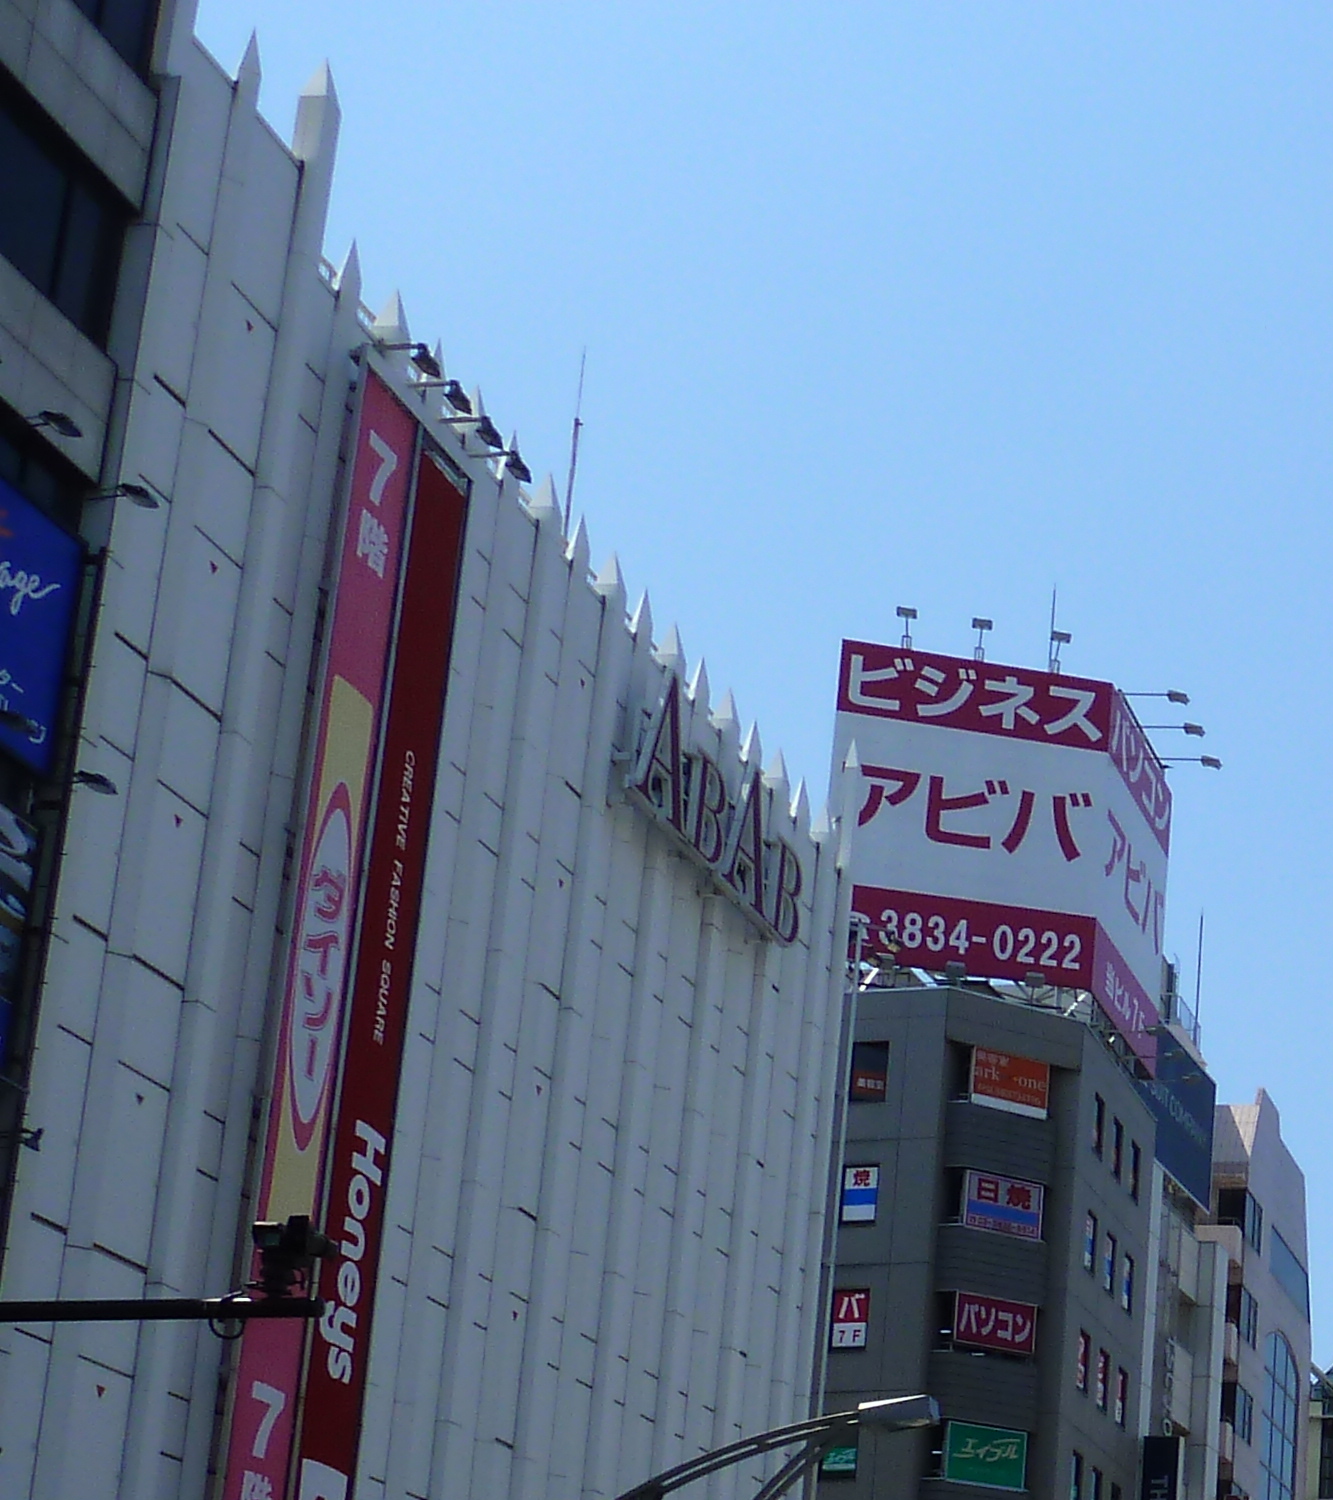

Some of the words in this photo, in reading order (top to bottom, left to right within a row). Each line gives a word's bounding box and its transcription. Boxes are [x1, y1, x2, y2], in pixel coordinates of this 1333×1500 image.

[353, 430, 398, 578] 7階
[848, 653, 1103, 741] ビジネス
[393, 748, 416, 853] CREATIVE
[858, 763, 1093, 862] アビバ
[381, 860, 407, 950] FASHION
[1104, 807, 1163, 956] アビバ
[880, 909, 1082, 971] 3834-0222
[373, 959, 393, 1045] SQUARE
[326, 1116, 388, 1386] Honeys
[959, 1302, 1032, 1344] パソコン
